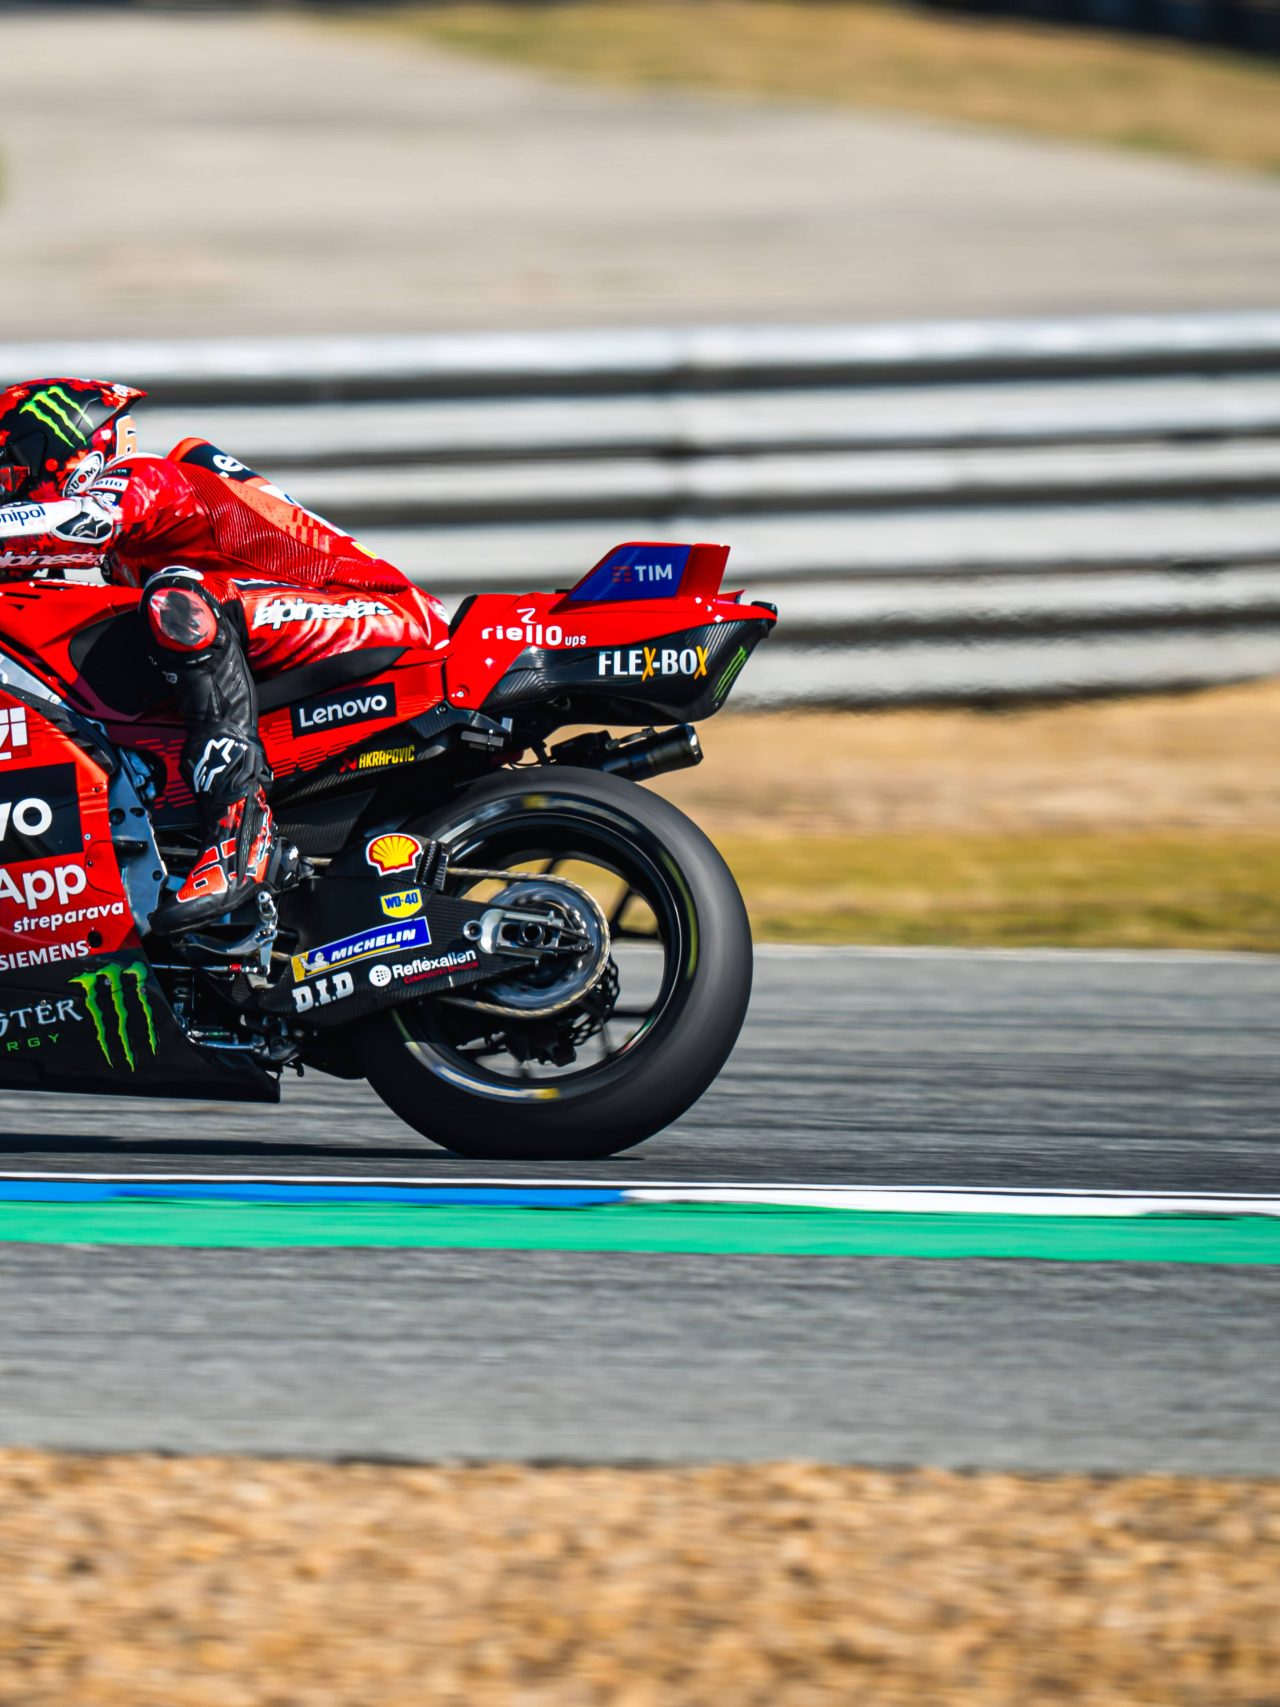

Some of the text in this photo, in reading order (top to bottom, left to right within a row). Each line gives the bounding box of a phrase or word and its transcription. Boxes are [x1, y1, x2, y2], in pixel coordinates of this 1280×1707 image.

[634, 564, 673, 582] TIM
[253, 598, 394, 630] alpinestars
[481, 623, 587, 647] riello ups
[598, 645, 708, 681] FLEX-BOX
[299, 694, 388, 728] Lenovo
[384, 892, 419, 909] WD-40
[13, 901, 124, 933] streparava
[330, 928, 417, 963] MICHELIN
